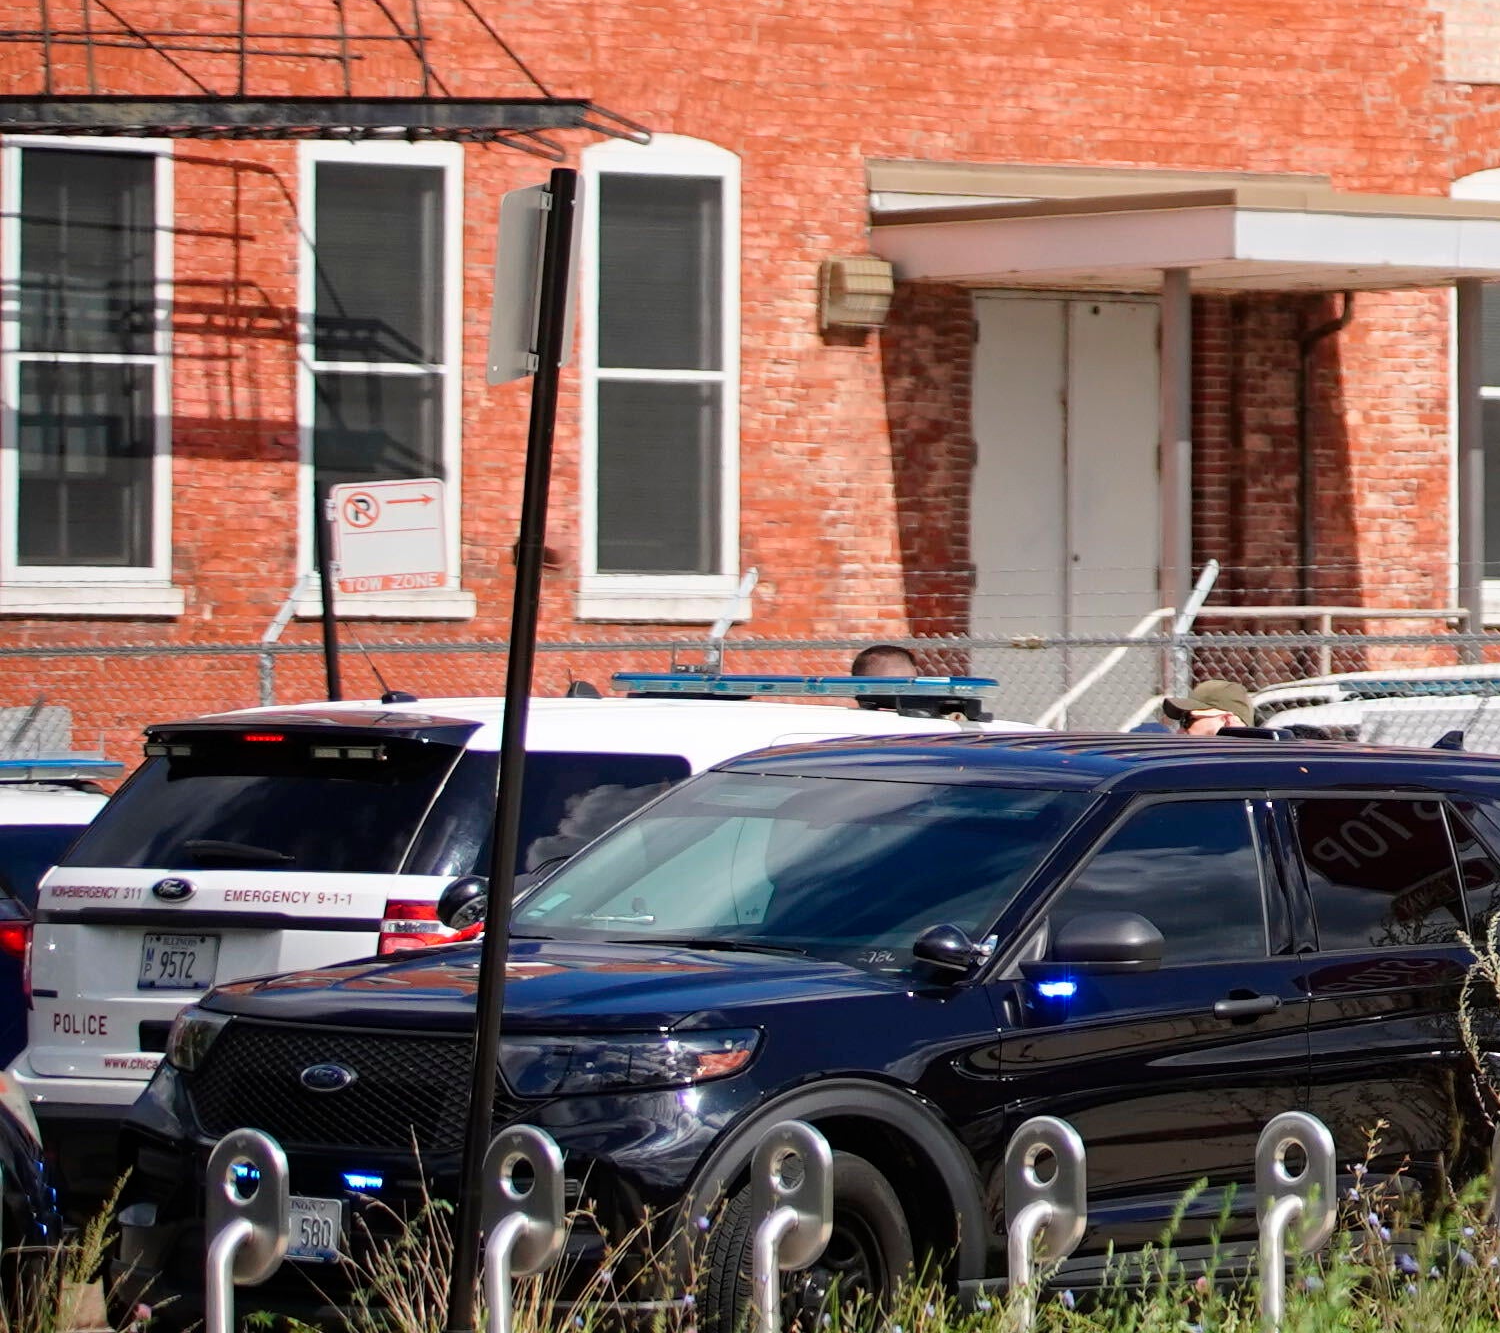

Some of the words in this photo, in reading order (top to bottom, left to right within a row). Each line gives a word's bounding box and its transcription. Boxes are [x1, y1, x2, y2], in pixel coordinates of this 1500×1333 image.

[344, 577, 384, 592] TOW
[391, 572, 438, 590] ZONE
[123, 887, 143, 900] 311
[224, 888, 310, 905] EMERGENCY
[317, 891, 353, 906] 9-1-1
[160, 951, 197, 979] 9572
[53, 1013, 108, 1036] POLICE
[301, 1217, 333, 1247] 580
